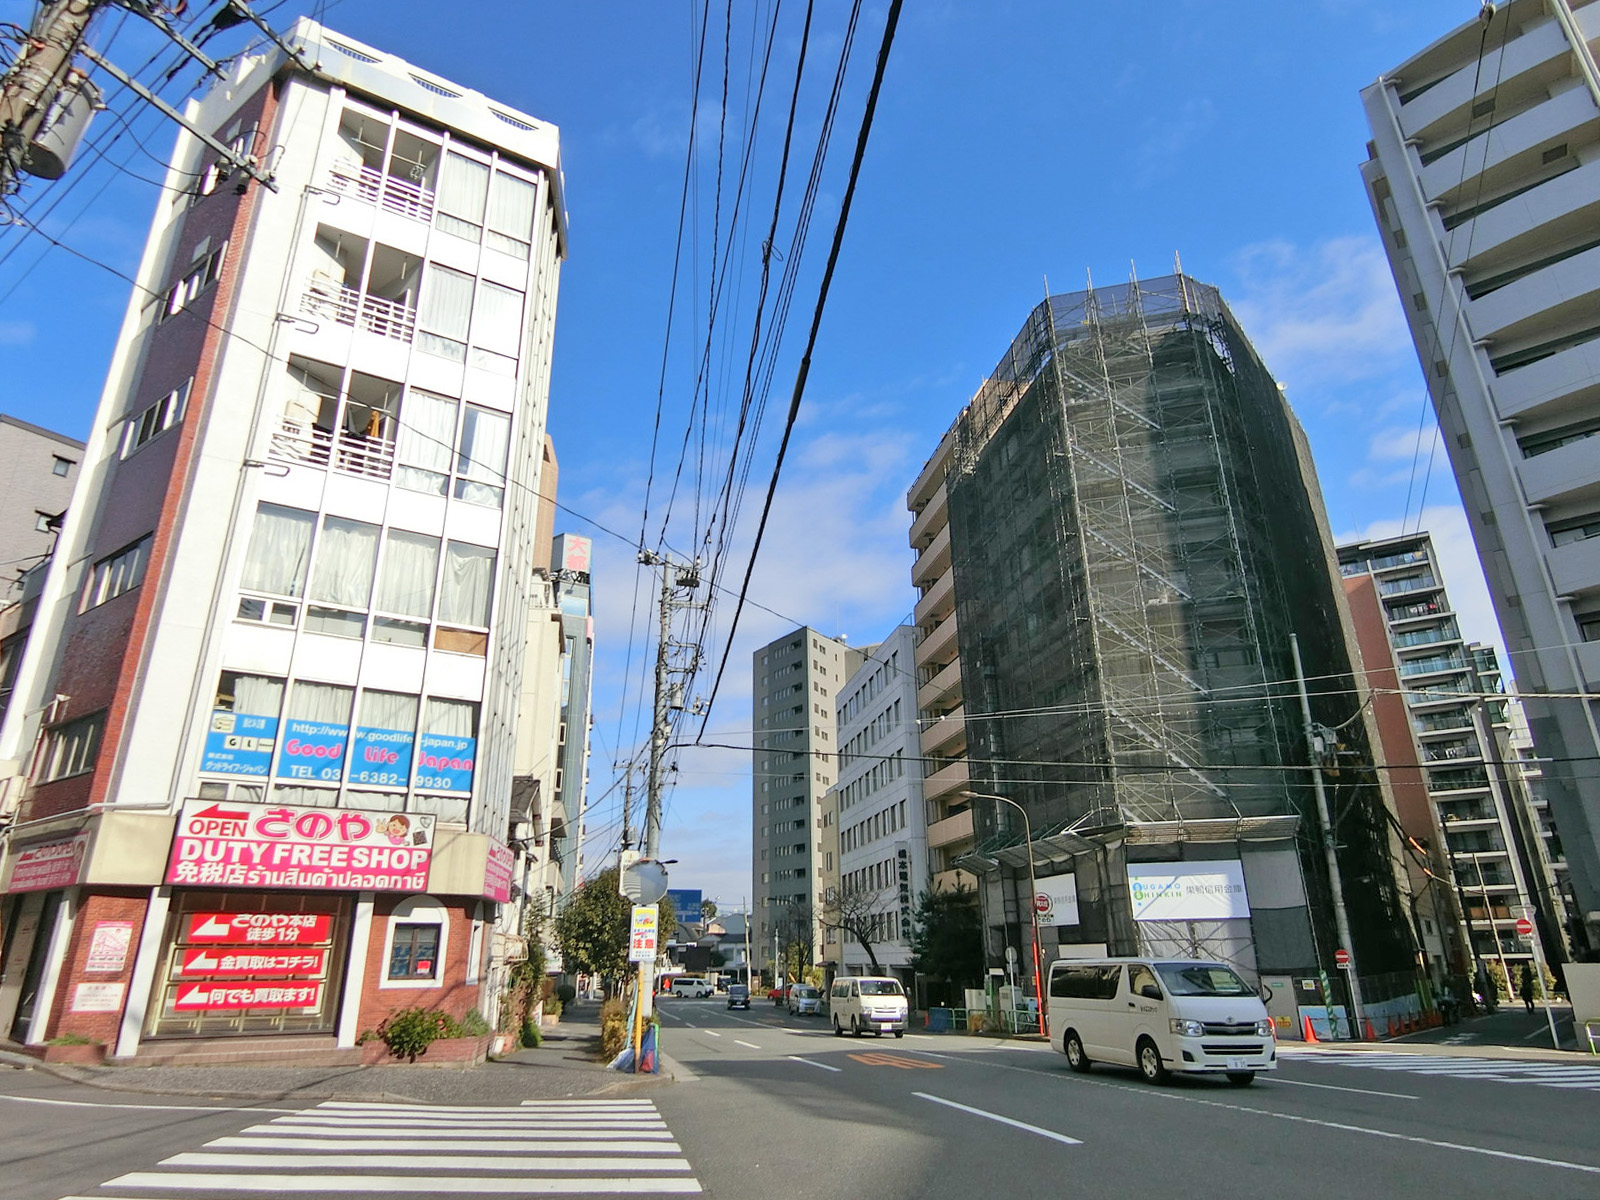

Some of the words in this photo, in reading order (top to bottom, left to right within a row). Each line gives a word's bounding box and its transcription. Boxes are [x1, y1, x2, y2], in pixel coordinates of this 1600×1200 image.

[286, 739, 342, 759] Good
[364, 746, 399, 764] Life
[417, 751, 473, 771] Japan
[290, 765, 316, 777] TEL
[188, 819, 247, 837] OPEN
[254, 807, 372, 841] さのや
[179, 839, 270, 864] DUTY
[272, 844, 349, 867] FREE
[351, 847, 428, 870] SHOP
[173, 861, 248, 884] 免税店
[231, 914, 318, 928] さのや本店
[246, 927, 300, 941] 徒歩1分
[633, 939, 654, 949] 注意
